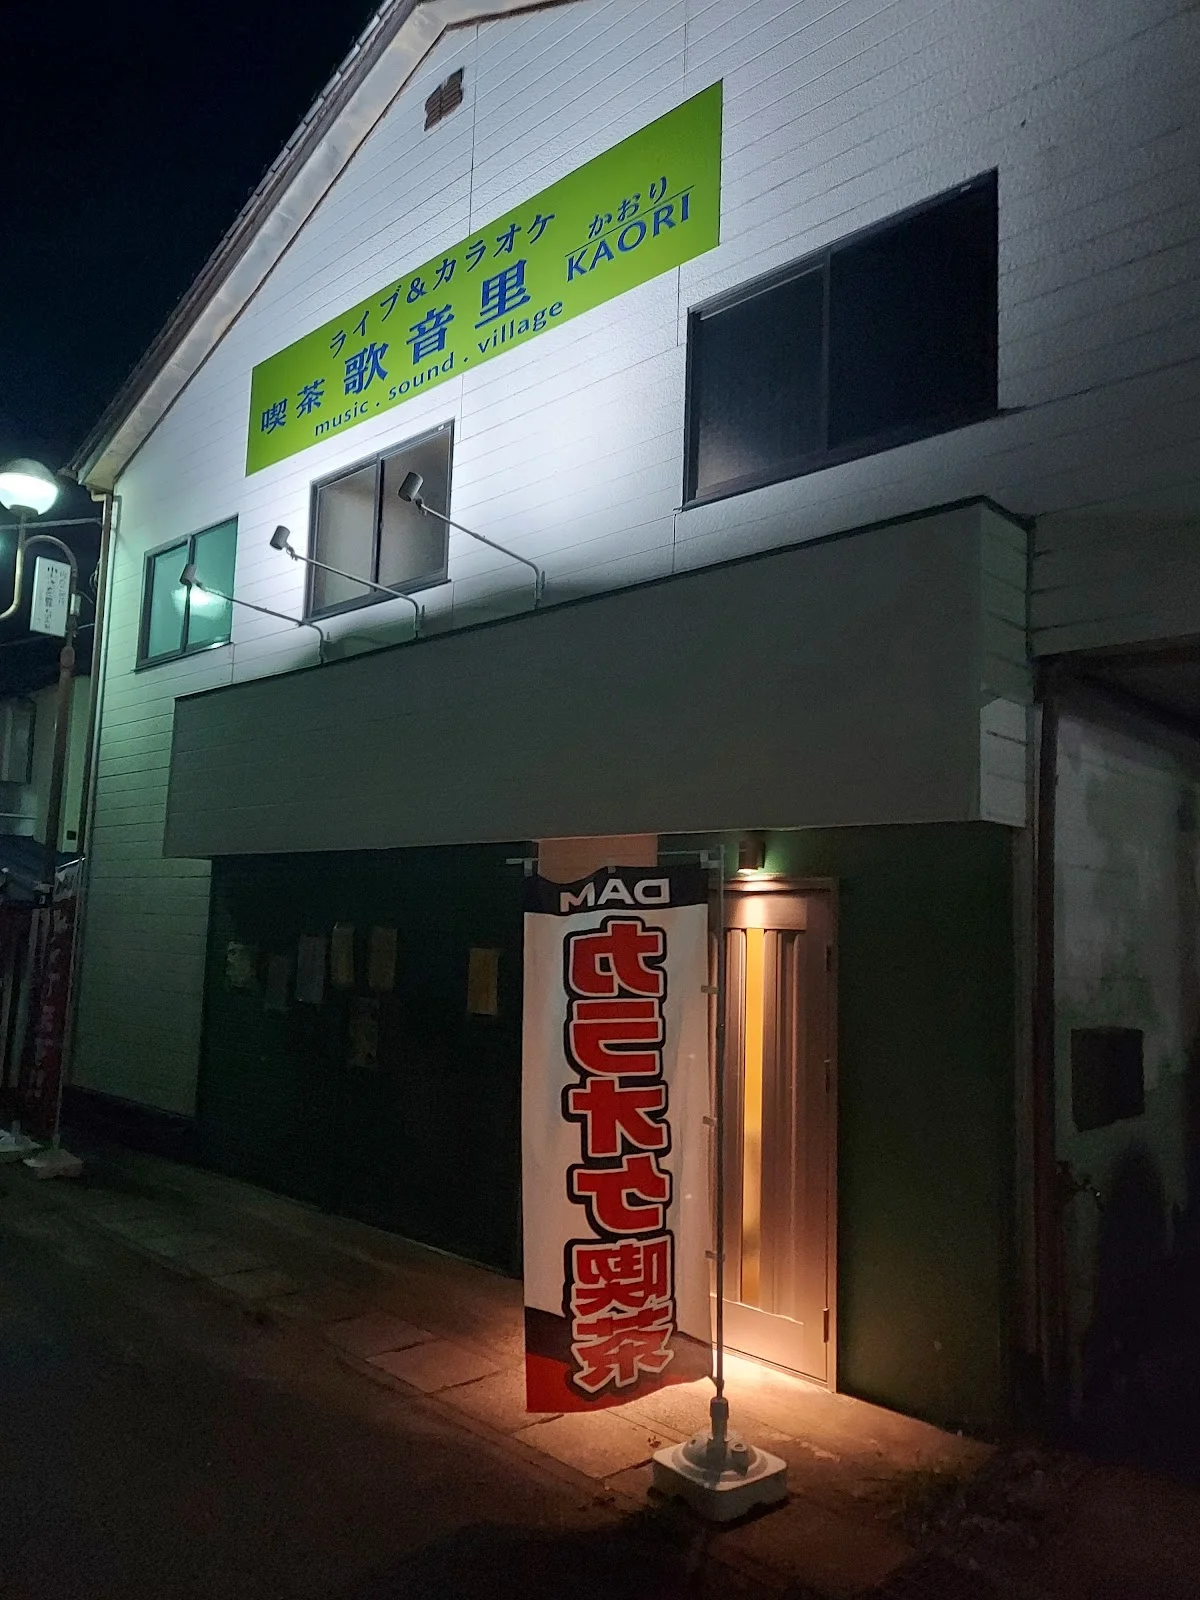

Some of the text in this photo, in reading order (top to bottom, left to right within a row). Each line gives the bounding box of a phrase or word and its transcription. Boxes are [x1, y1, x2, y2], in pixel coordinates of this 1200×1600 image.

[567, 193, 690, 283] KAORI
[588, 176, 667, 239] かおり
[260, 259, 531, 435] 喫茶 歌音里
[389, 352, 454, 400] sound
[478, 301, 563, 353] village
